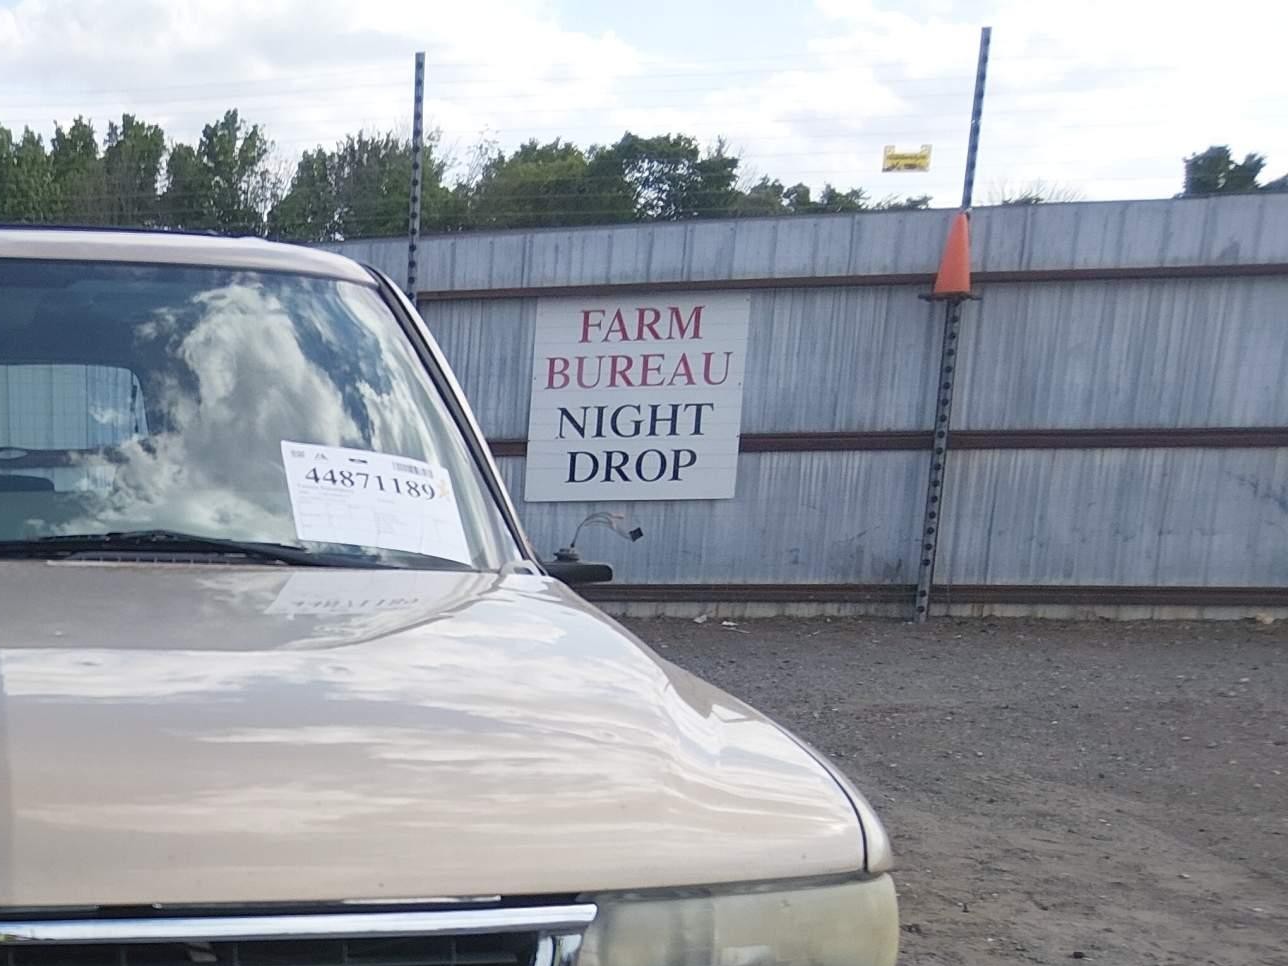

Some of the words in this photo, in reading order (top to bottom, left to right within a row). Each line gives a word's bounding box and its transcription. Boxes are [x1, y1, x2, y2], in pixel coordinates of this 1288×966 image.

[578, 305, 704, 342] FARM
[544, 352, 734, 389] BUREAU
[557, 403, 714, 439] NIGHT
[305, 467, 435, 500] 44871189
[565, 449, 697, 483] DROP
